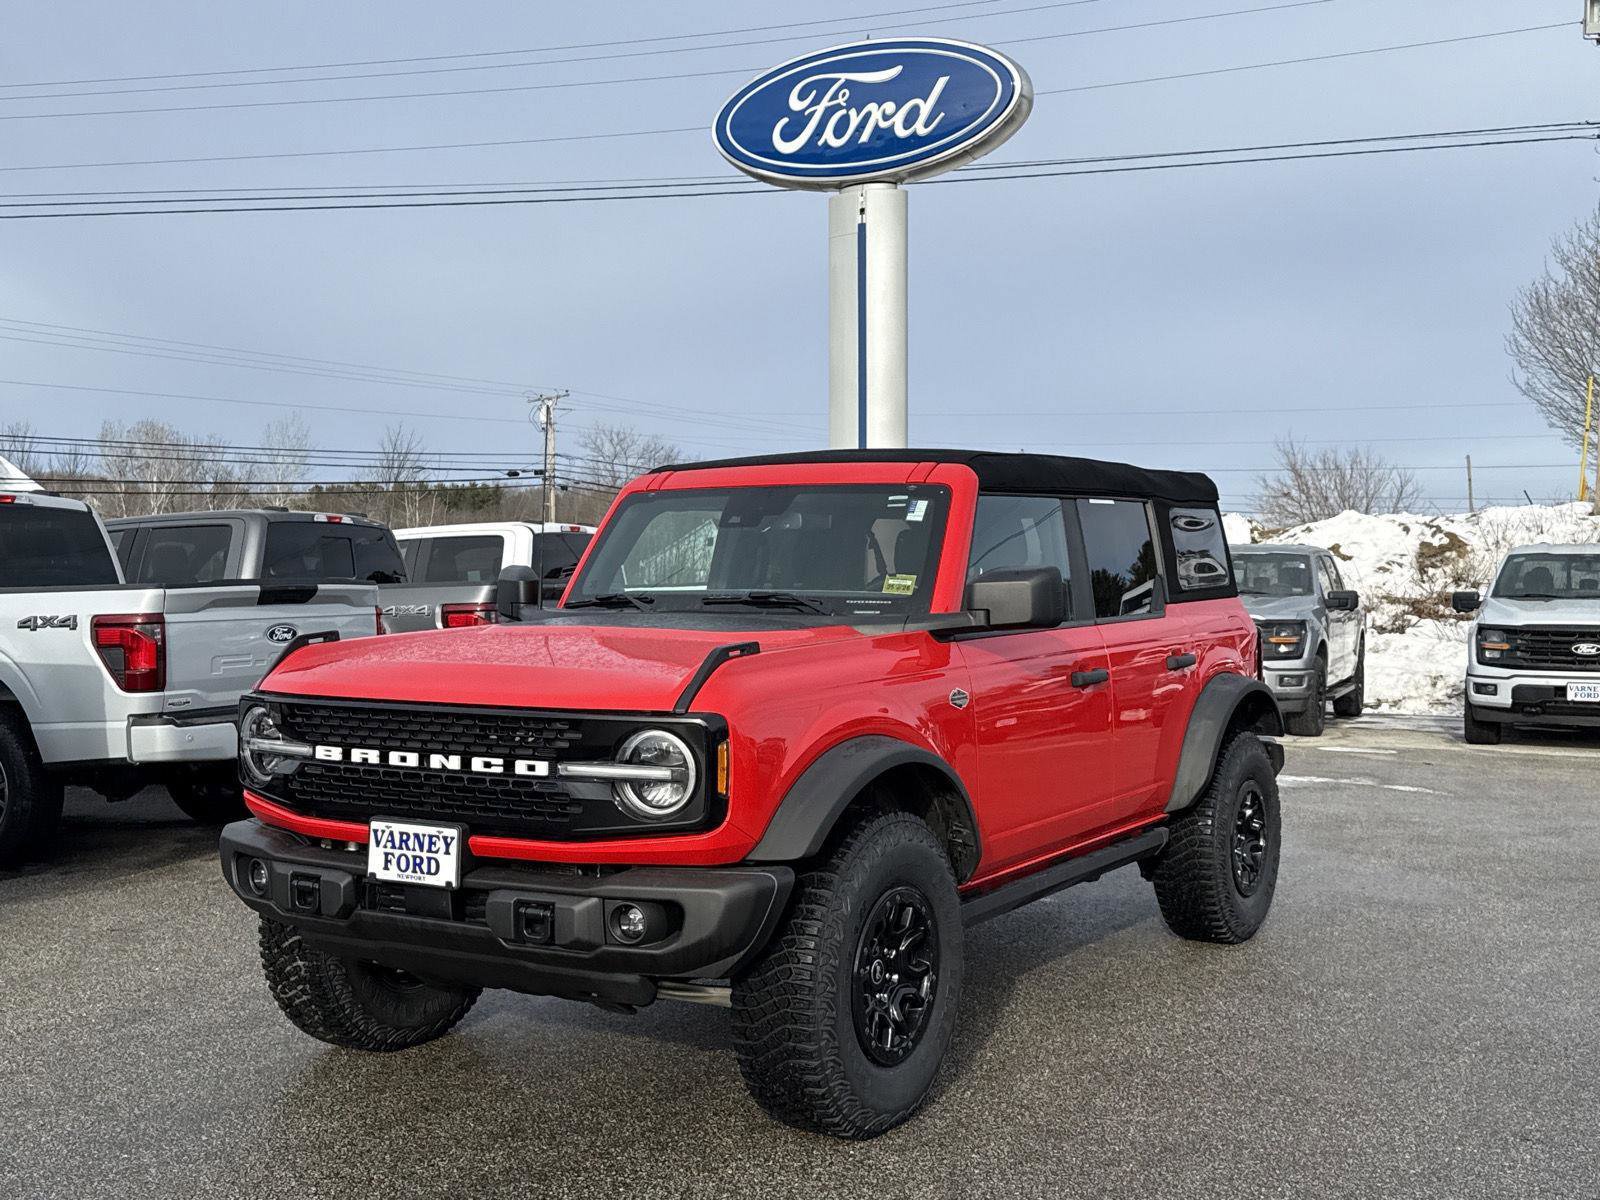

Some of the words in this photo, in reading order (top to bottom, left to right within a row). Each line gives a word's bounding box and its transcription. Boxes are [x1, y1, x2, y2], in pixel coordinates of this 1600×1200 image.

[772, 65, 950, 154] Ford
[273, 627, 294, 641] Ford
[315, 745, 549, 776] BRONCO
[372, 828, 456, 855] VARNEY
[382, 851, 441, 876] FORD
[396, 873, 427, 881] NEWPORT
